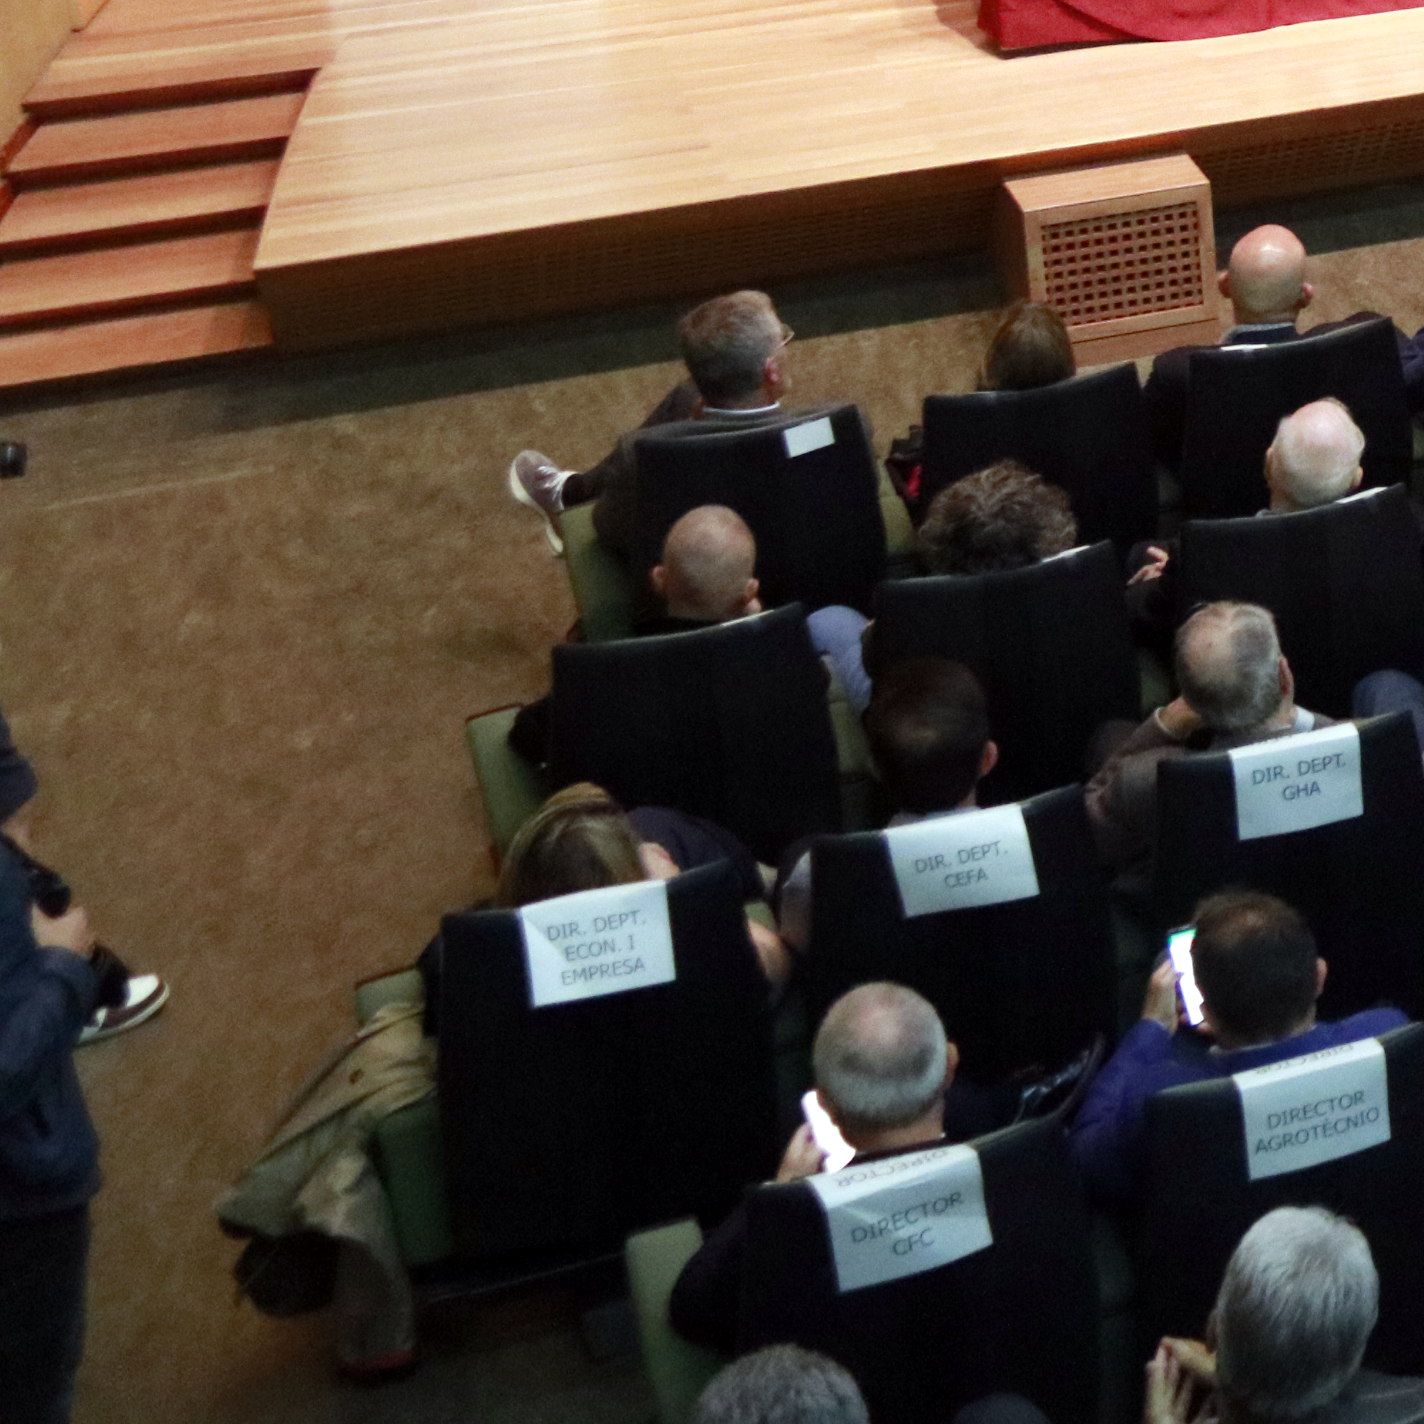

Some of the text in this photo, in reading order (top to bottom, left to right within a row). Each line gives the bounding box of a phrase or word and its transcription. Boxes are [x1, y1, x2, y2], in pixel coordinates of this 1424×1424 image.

[1252, 753, 1346, 786] DIR. DEPT.
[1282, 781, 1321, 801] GHA
[913, 841, 1007, 876] DIR. DEPT.
[942, 867, 988, 890] CEFA
[546, 909, 645, 942] DIR. DEPT.
[563, 939, 624, 962] ECON.
[561, 958, 645, 985] EMPRESA
[1267, 1091, 1364, 1129] DIRECTOR
[851, 1191, 965, 1243] DIRECTOR
[892, 1227, 935, 1265] CFC
